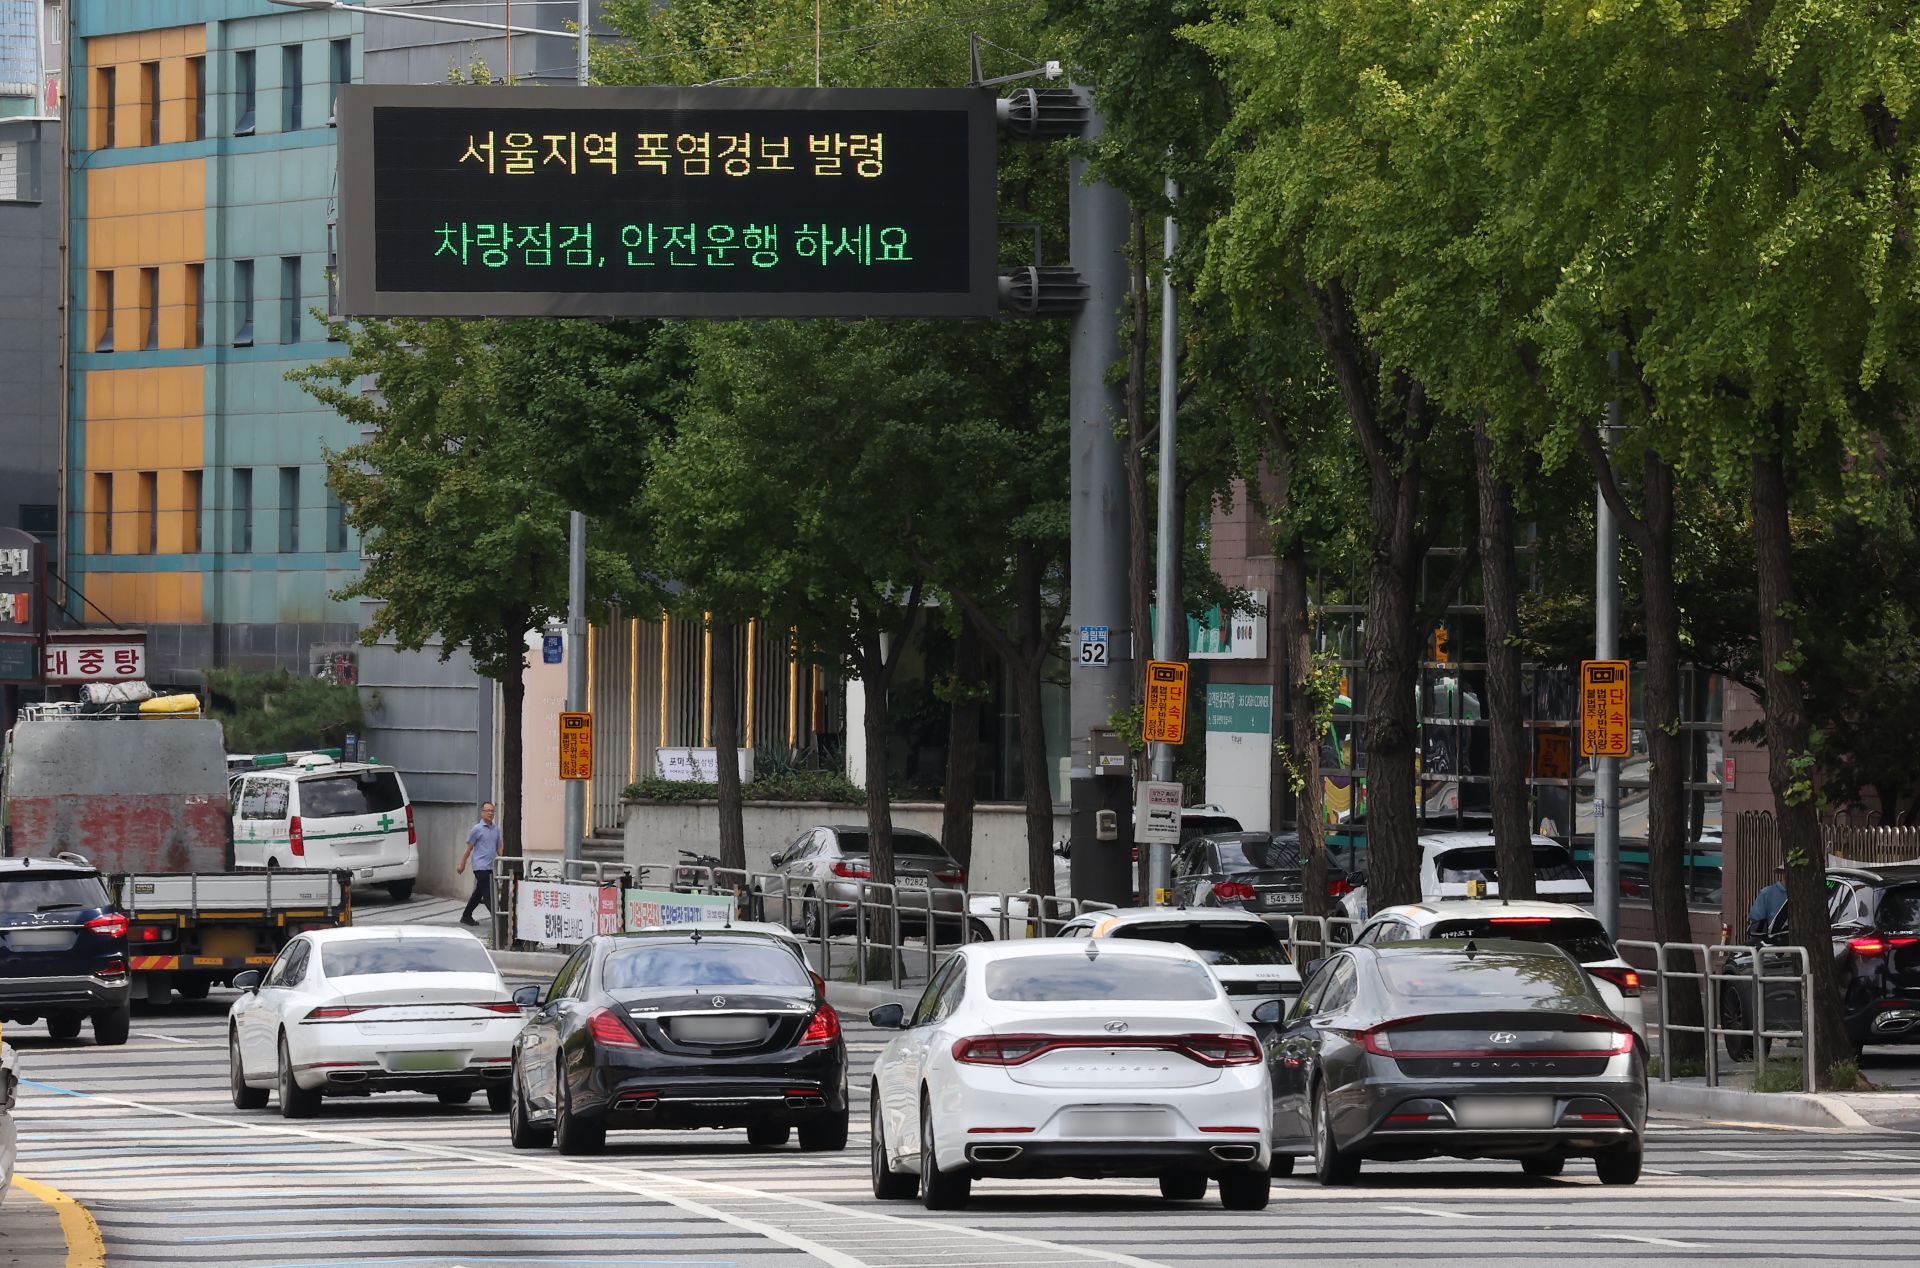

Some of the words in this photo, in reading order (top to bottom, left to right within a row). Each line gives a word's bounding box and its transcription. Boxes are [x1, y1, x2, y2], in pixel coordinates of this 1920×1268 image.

[459, 131, 618, 175] 서울지역
[634, 131, 795, 176] 폭염경보
[808, 132, 884, 177] 발령
[434, 222, 605, 268] 차량점검,
[621, 222, 779, 268] 안전운행
[794, 223, 914, 266] 하세요
[1081, 630, 1107, 640] 올림픽
[1082, 643, 1105, 662] 52
[1157, 686, 1168, 738] 법규위반차량
[1597, 689, 1607, 750] 법규위반차량
[1440, 930, 1466, 939] 카카오
